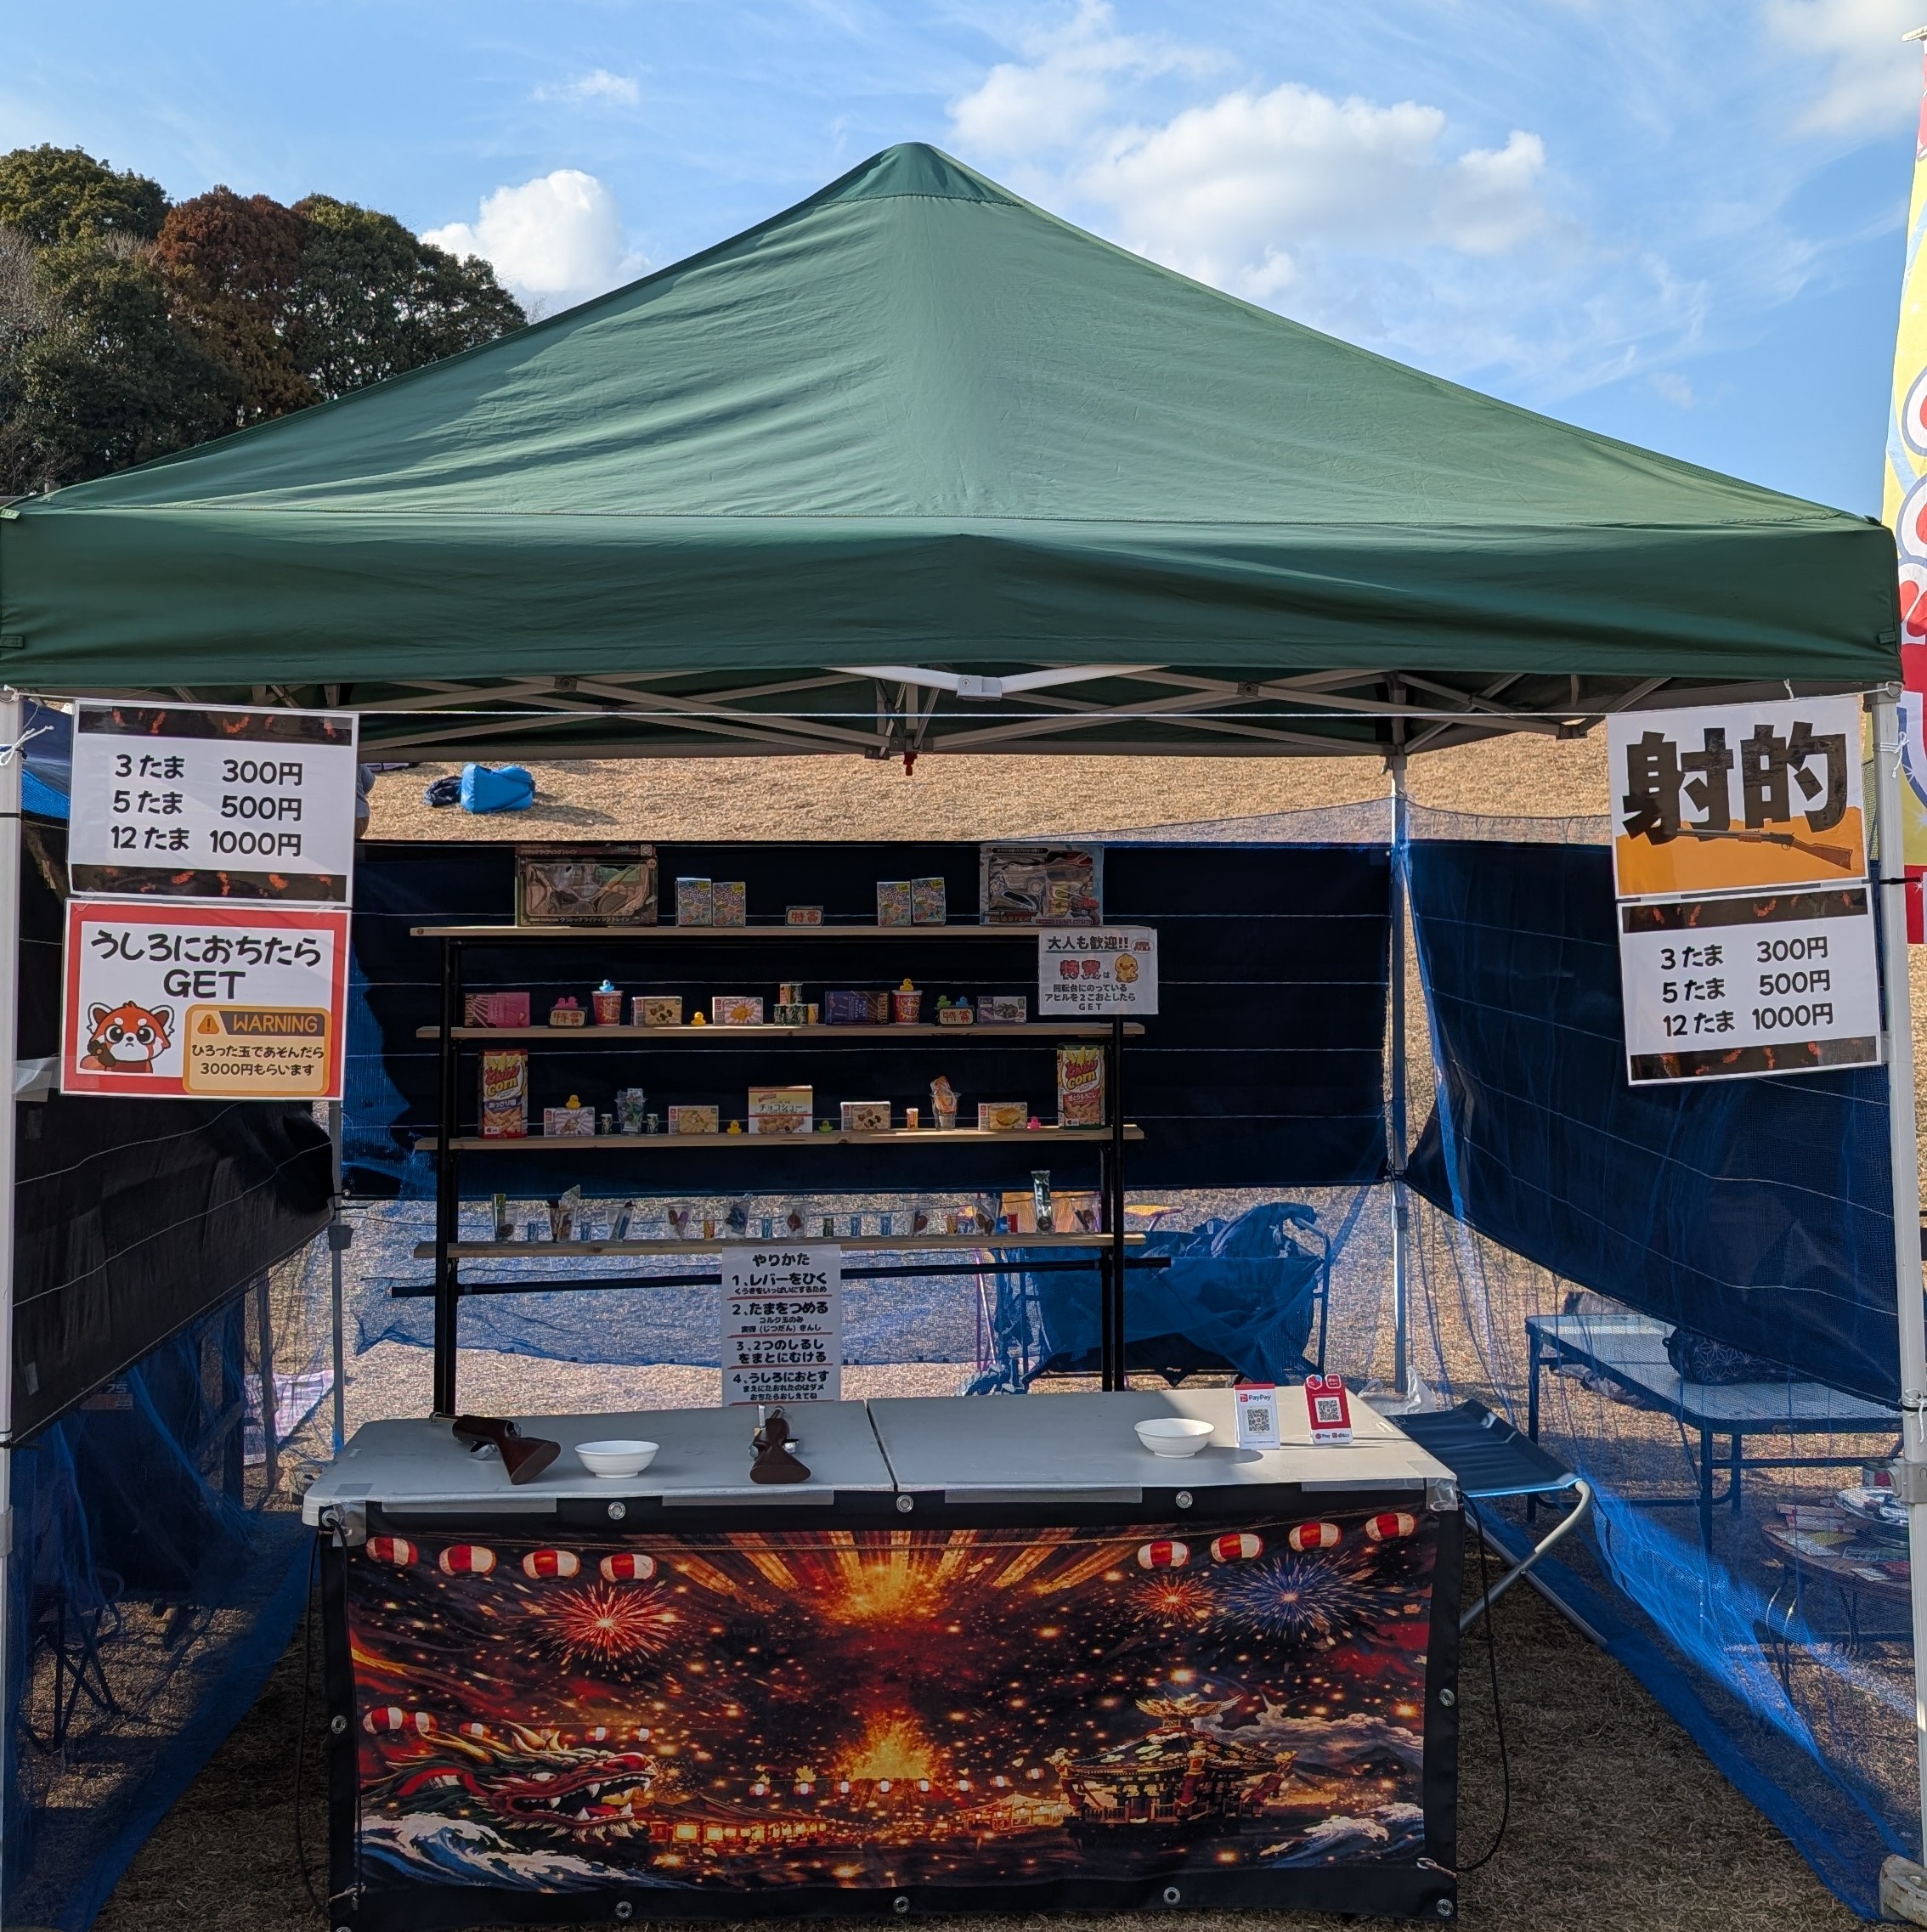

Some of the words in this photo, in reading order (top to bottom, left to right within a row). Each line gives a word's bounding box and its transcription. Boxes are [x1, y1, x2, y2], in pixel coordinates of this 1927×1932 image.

[221, 760, 303, 787] 300円
[1622, 720, 1847, 846] 射的
[220, 795, 302, 822] 500円
[209, 829, 302, 857] 1000円
[90, 929, 322, 968] うしろにおちたら
[1756, 936, 1828, 963] 300円
[163, 970, 246, 999] GET
[1053, 984, 1127, 992] 回転台にのっている
[1759, 969, 1831, 997] 500円
[232, 1014, 319, 1033] WARNING
[1751, 1003, 1834, 1031] 1000円
[191, 1044, 325, 1059] ひろった玉であそんだら
[201, 1062, 315, 1077] 3000円もらいます
[487, 1077, 518, 1097] corn
[1066, 1071, 1096, 1090] corn
[752, 1253, 810, 1267] やりかた
[738, 1351, 827, 1364] をまとにむける
[743, 1383, 825, 1393] まえにたおれたのはダメ
[749, 1392, 817, 1401] おちたらおしえてね
